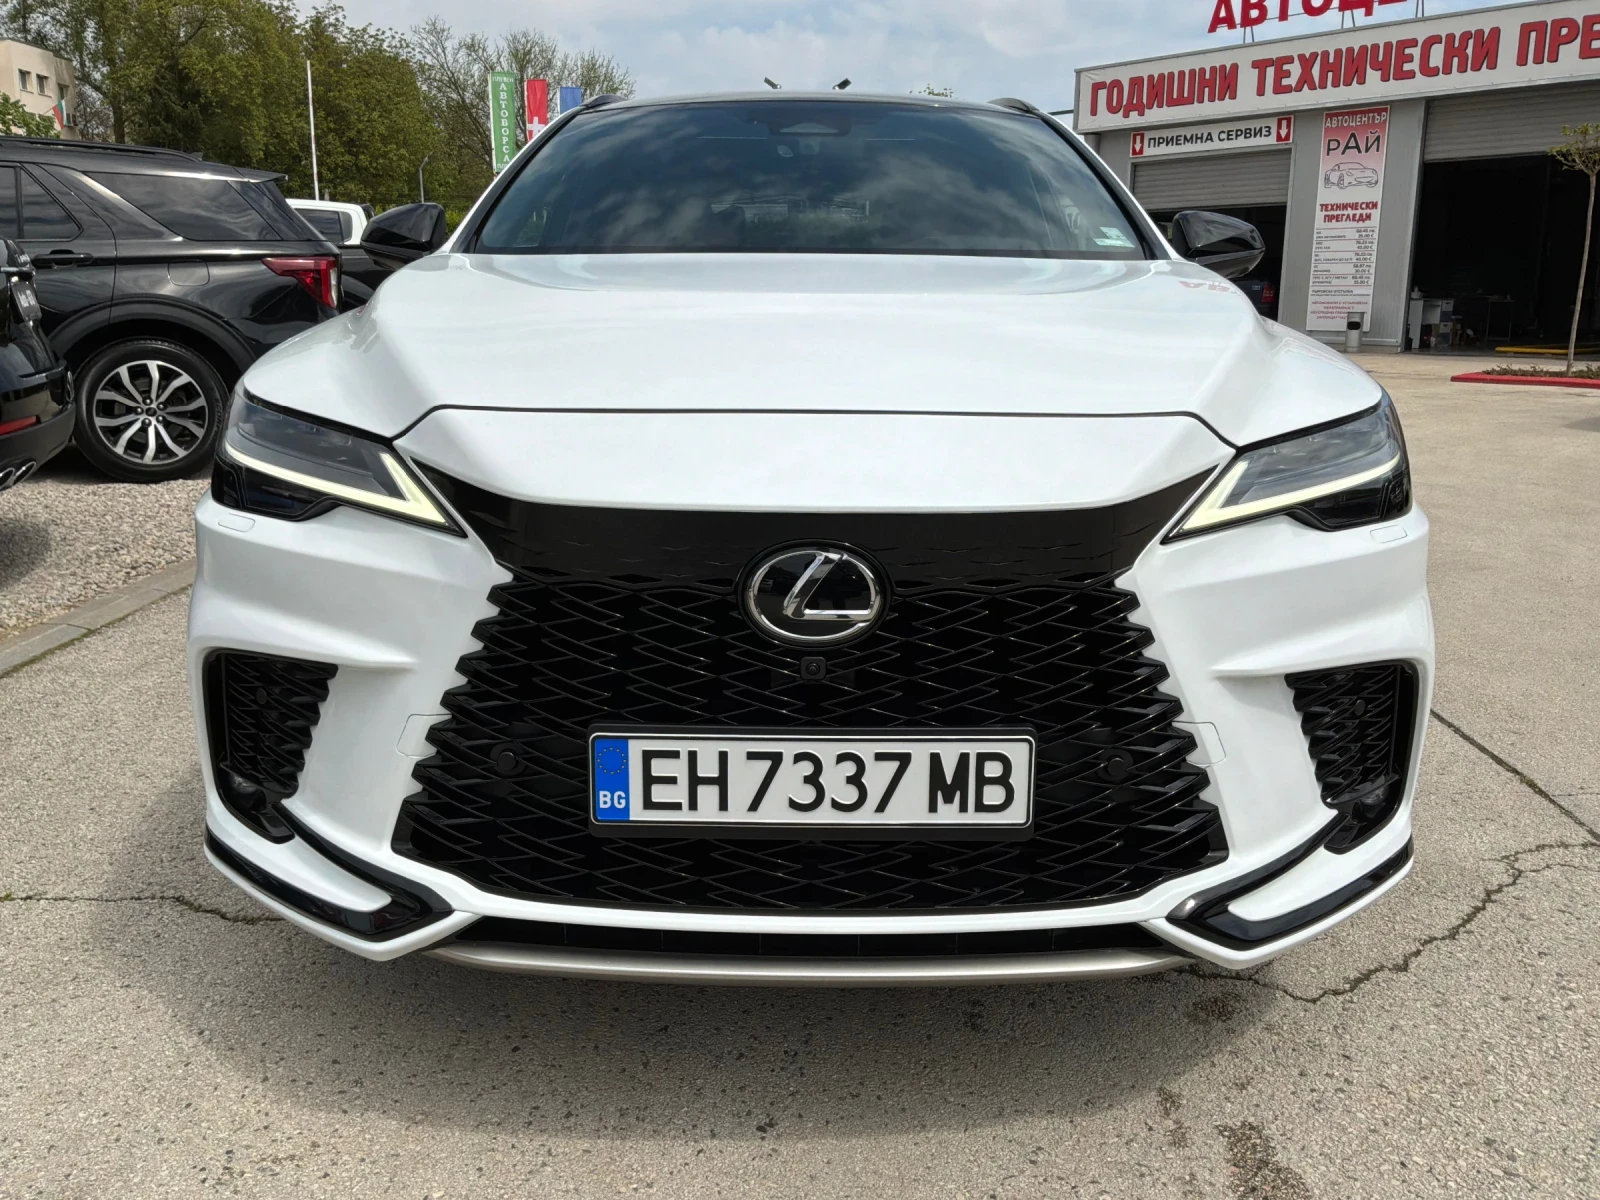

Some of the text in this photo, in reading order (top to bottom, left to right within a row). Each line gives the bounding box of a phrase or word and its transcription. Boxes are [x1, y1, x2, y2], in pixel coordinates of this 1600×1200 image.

[1090, 14, 1600, 118] ГОДИШНИ ТЕХНИЧЕСКИ ПРЕ
[499, 83, 510, 162] АВТОБОРСА
[1325, 111, 1387, 128] АВТОЦЕНТЪР
[1147, 125, 1272, 148] ПРИЕМНА СЕРВИЗ
[1326, 129, 1381, 156] РАЙ
[1319, 201, 1379, 213] ТЕХНИЧЕСКИ
[1323, 212, 1372, 223] ПРЕГЛЕДИ
[641, 748, 1015, 814] EH 7337 MB
[598, 791, 627, 809] BG
